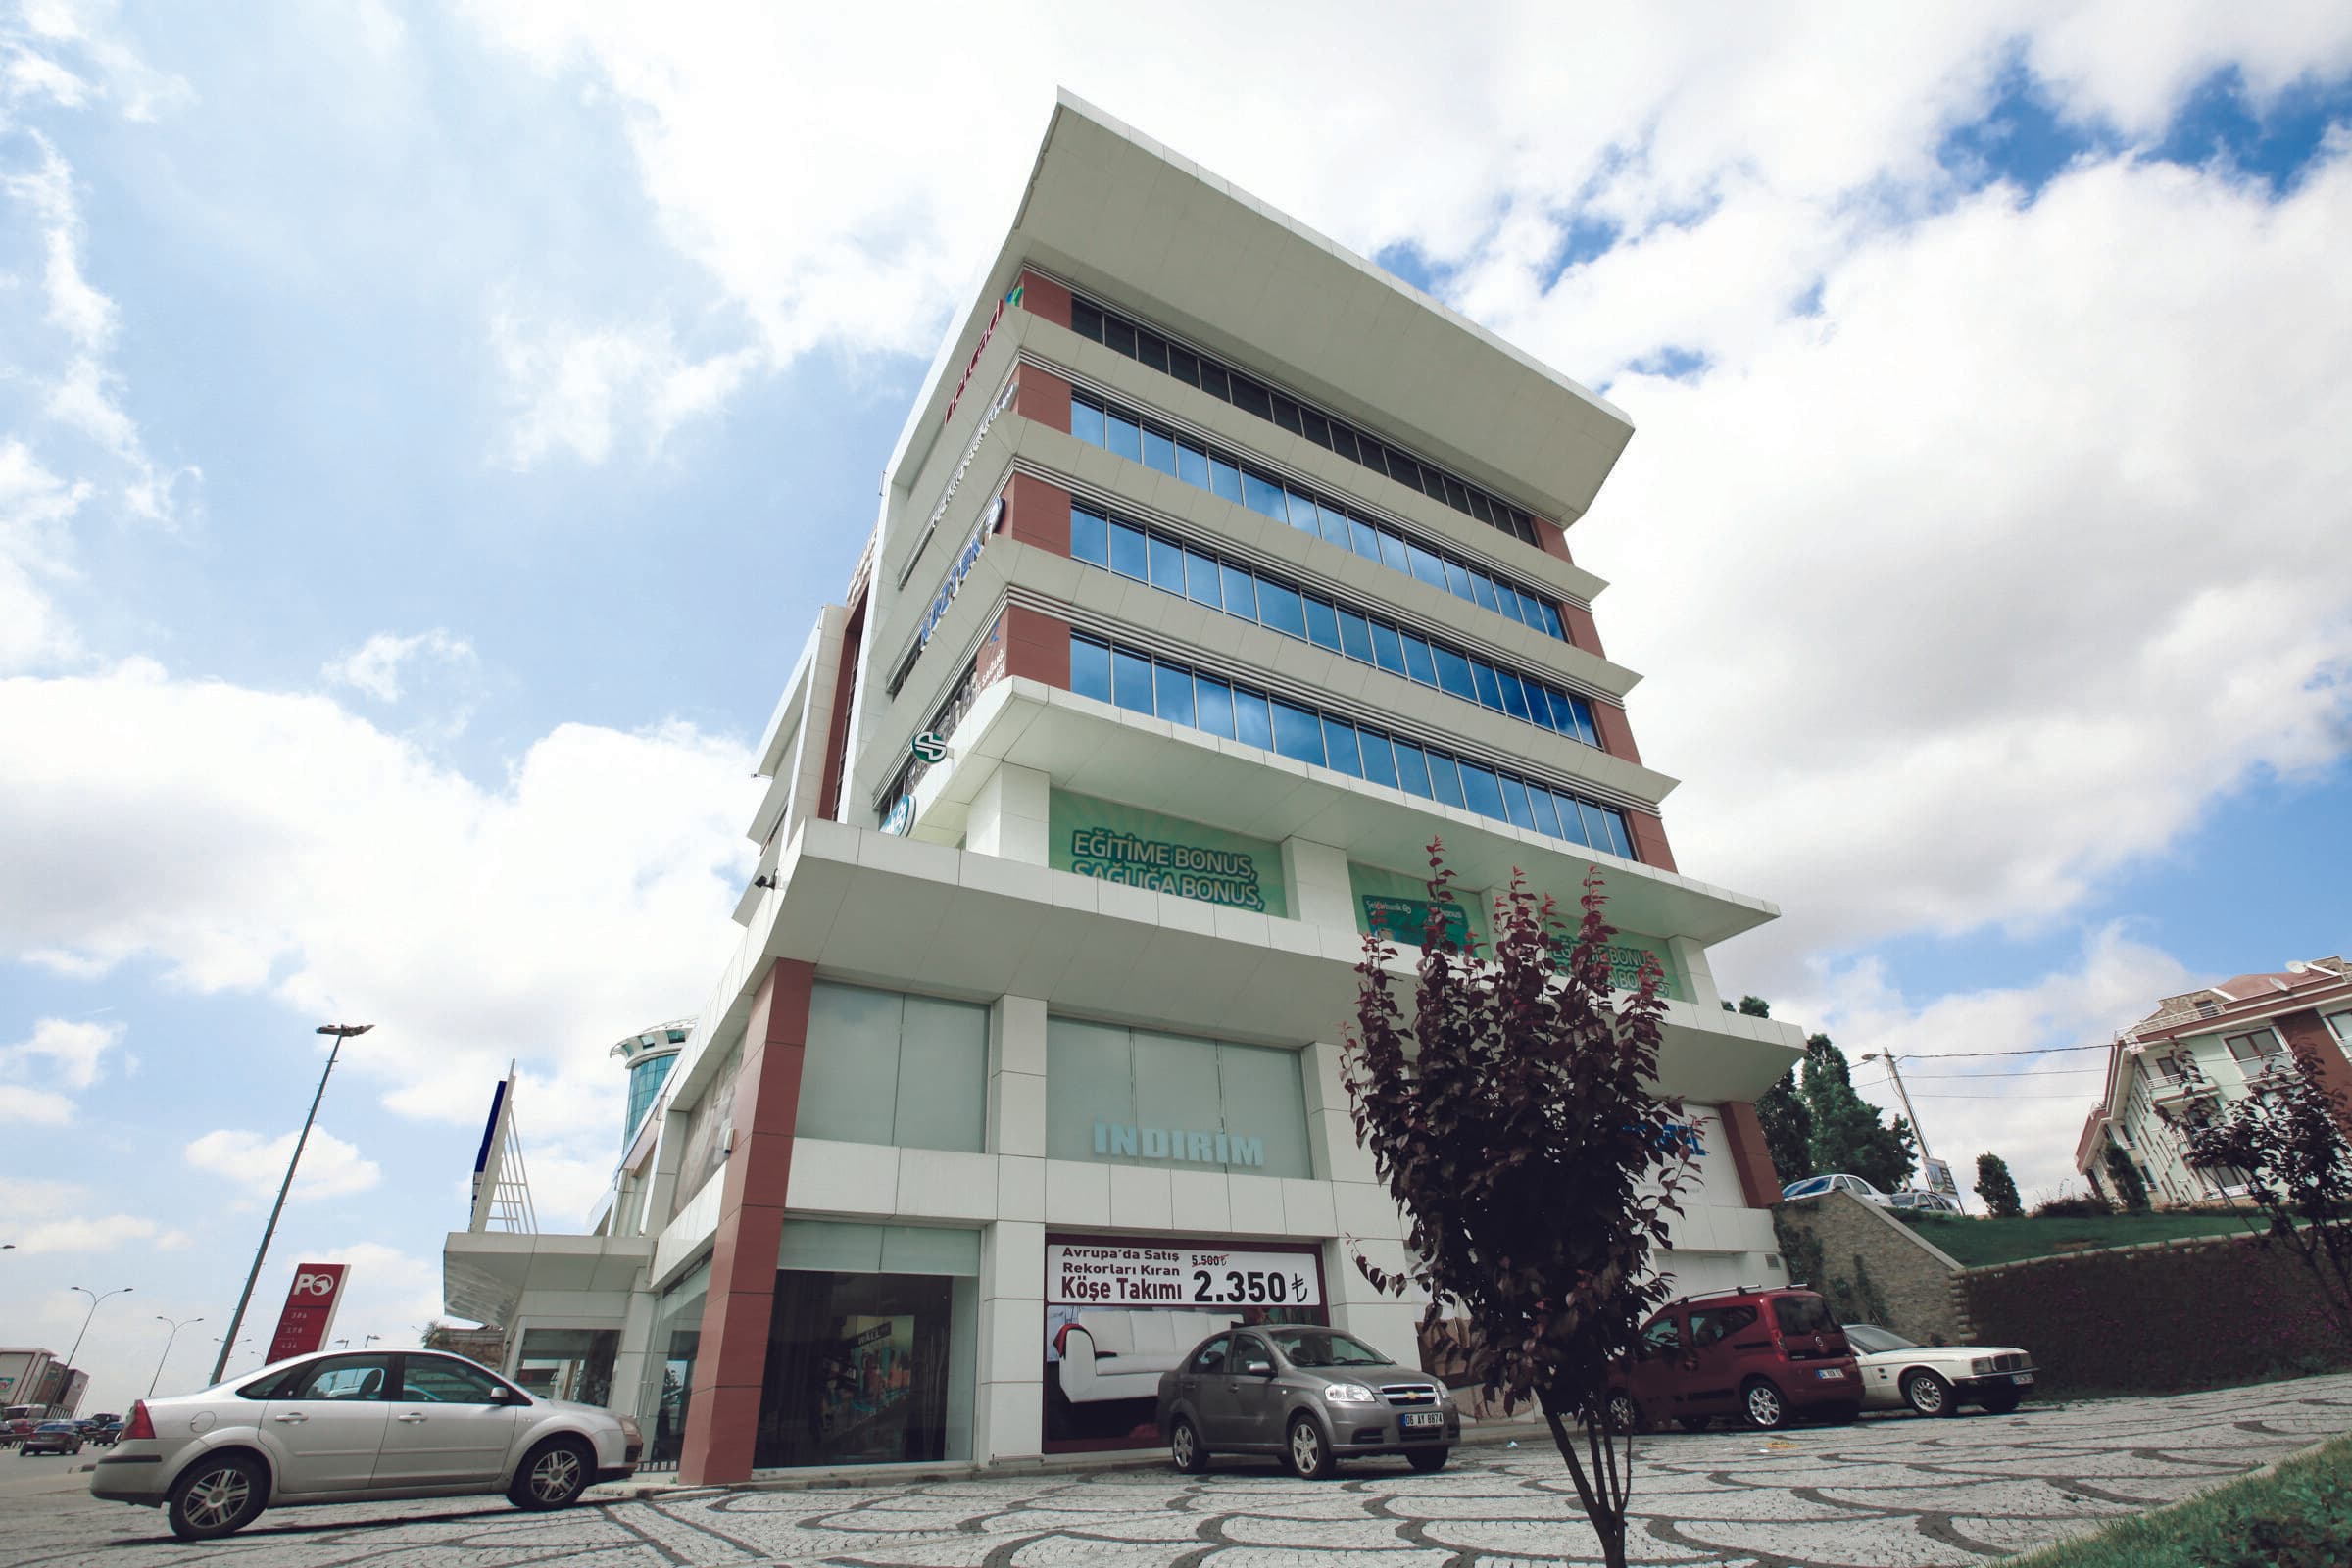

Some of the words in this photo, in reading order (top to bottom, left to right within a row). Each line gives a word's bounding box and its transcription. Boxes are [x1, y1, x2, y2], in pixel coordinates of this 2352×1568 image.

[1074, 829, 1170, 865] EĞİTİME
[1175, 847, 1257, 880] BONUS,
[1062, 1247, 1140, 1260] Avrupa'da
[1145, 1250, 1179, 1262] Satış
[1063, 1262, 1136, 1275] Rekorları
[1141, 1265, 1180, 1276] Kıran
[1062, 1275, 1111, 1301] Köşe
[1116, 1277, 1182, 1300] Takımı
